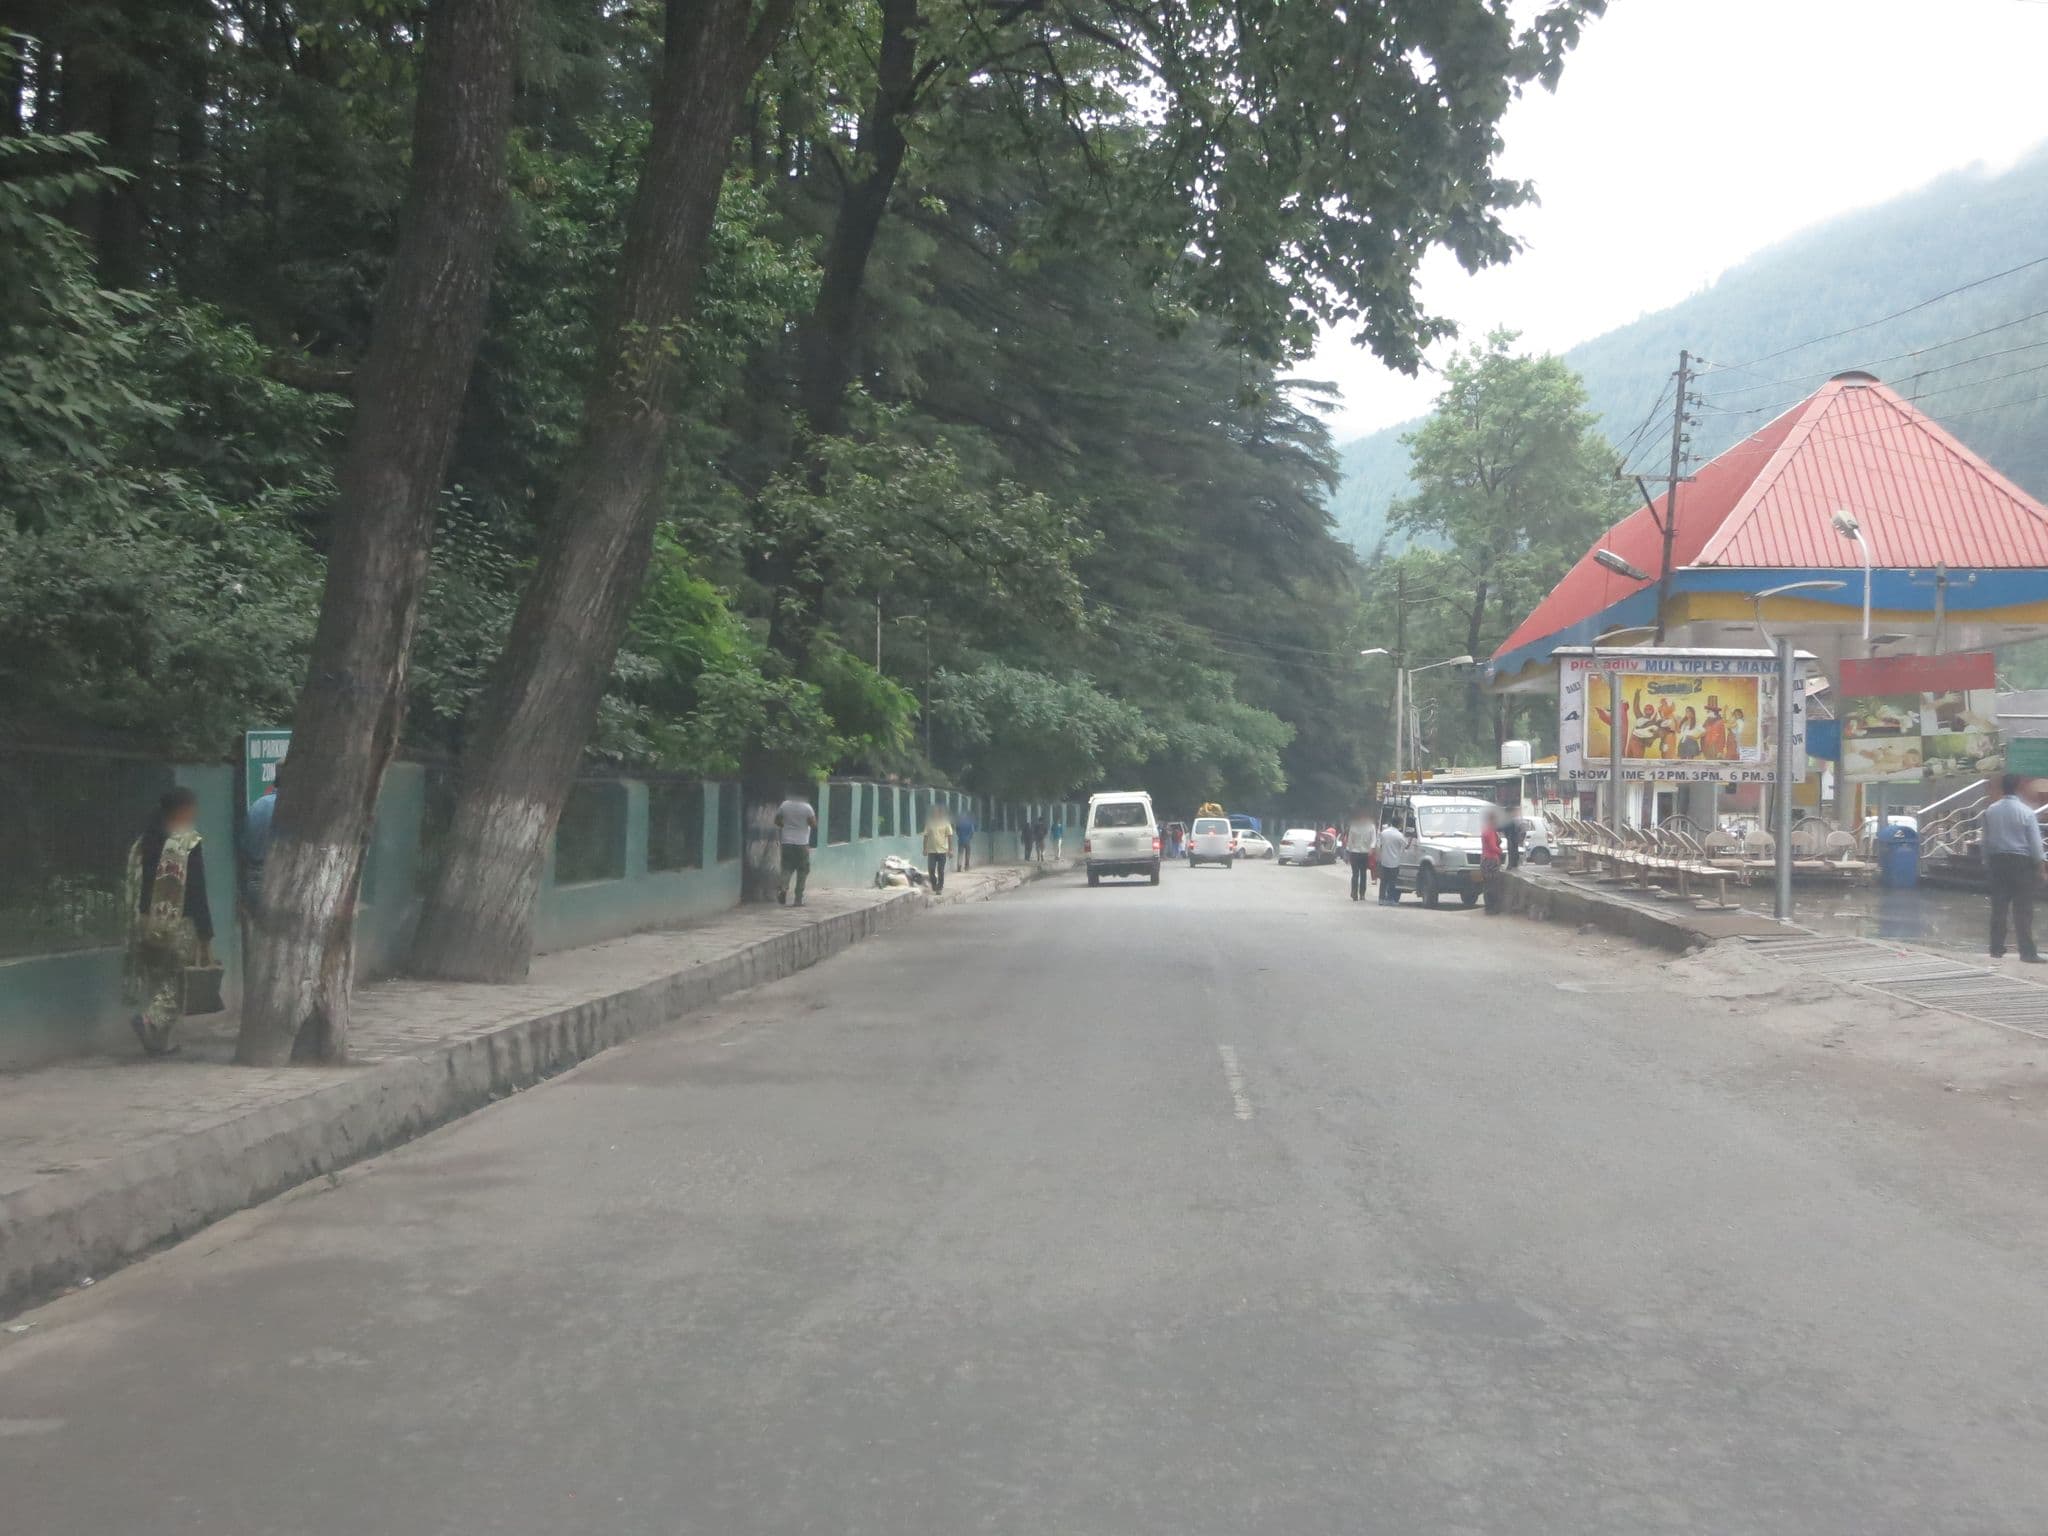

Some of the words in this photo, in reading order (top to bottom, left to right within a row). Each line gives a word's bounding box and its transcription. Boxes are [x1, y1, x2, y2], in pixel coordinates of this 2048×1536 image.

[1645, 659, 1730, 673] MULTIPLEX
[1737, 660, 1798, 673] MANAI
[1568, 769, 1608, 780] SHOW
[1620, 770, 1645, 780] IME
[1692, 771, 1724, 781] 3PM.
